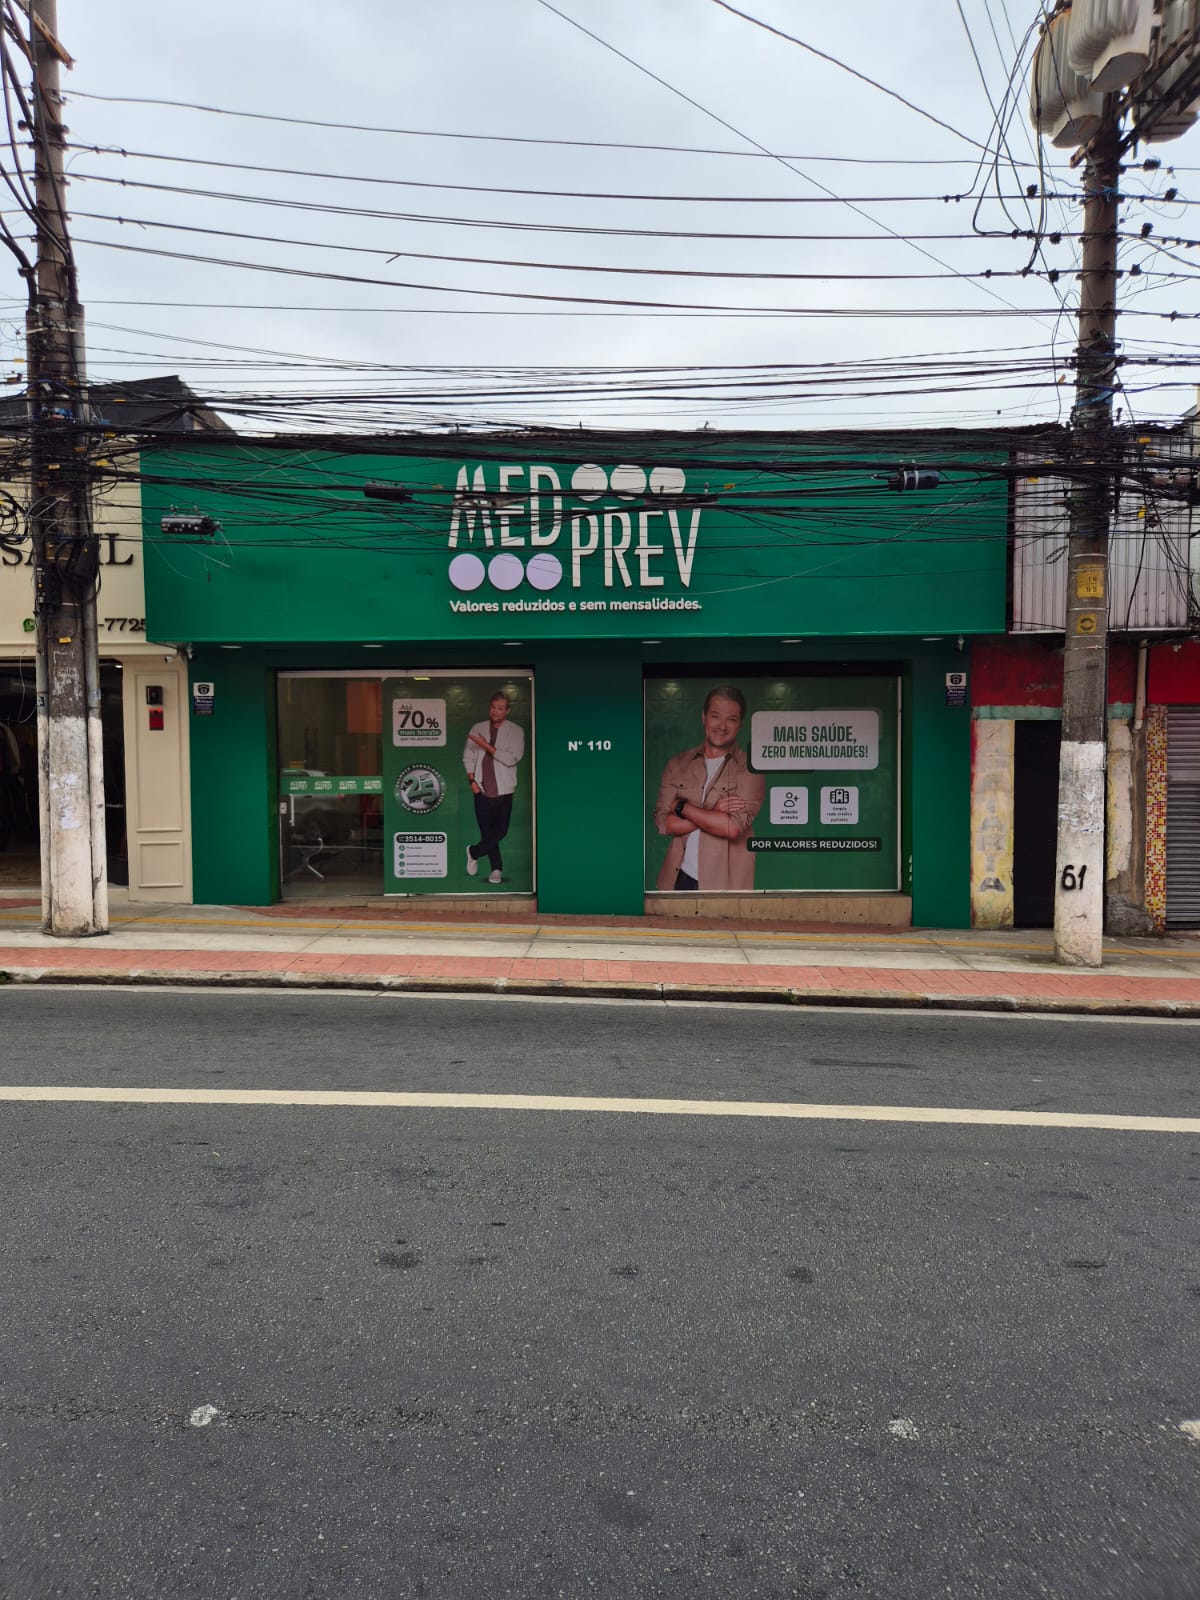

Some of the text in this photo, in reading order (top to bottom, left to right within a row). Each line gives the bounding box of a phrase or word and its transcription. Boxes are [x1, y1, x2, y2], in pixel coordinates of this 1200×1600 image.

[448, 464, 562, 547] MED
[571, 506, 701, 588] PREV
[449, 597, 702, 612] Valores reduzidos e sem mensalidades.
[773, 723, 857, 744] MAIS SAÚDE,
[587, 740, 611, 751] 110
[761, 745, 869, 758] ZERO MENSALIDADES!
[751, 840, 877, 849] POR VALORES REDUZIDOS!
[1061, 864, 1087, 891] 61
